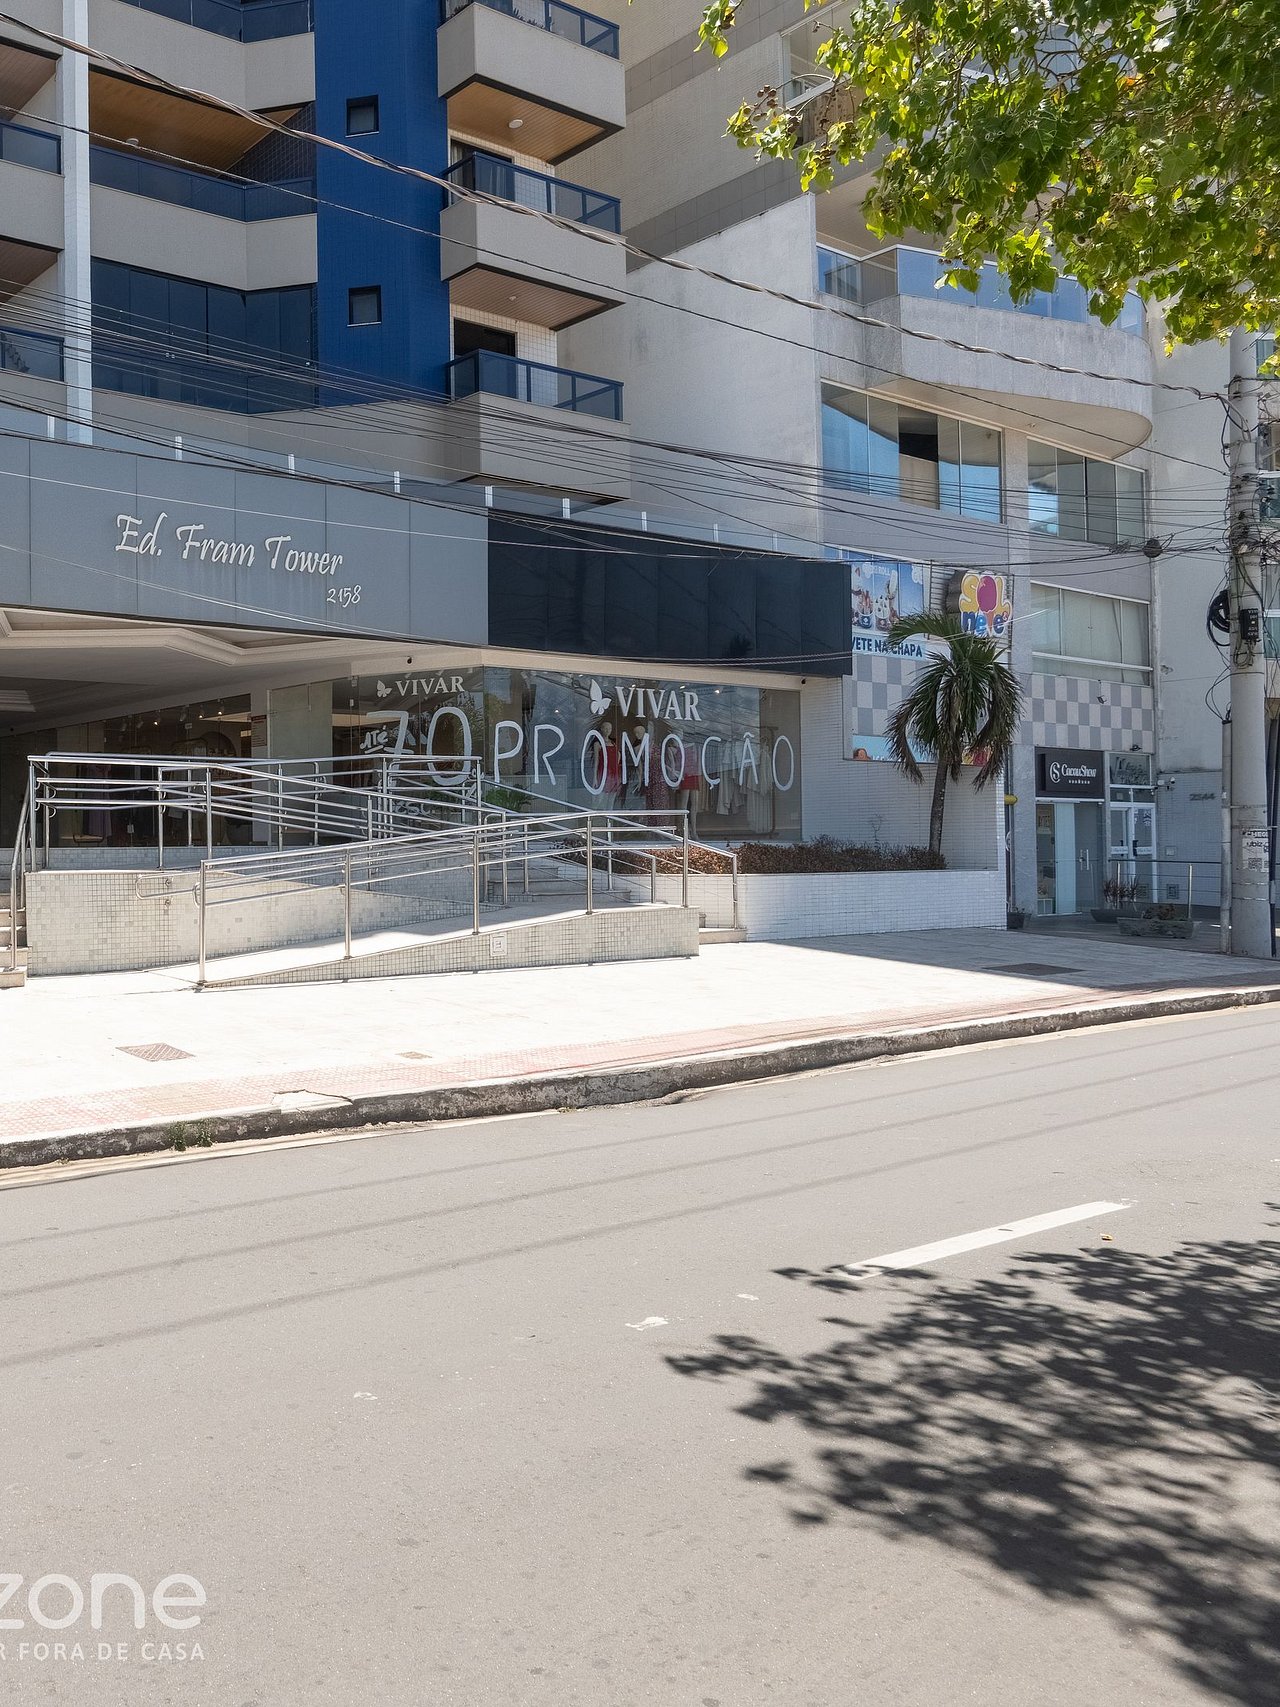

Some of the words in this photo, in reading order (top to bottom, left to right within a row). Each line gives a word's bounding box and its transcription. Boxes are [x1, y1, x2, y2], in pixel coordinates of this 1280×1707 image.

[115, 511, 168, 557] Ed.
[175, 523, 256, 568] Fram
[265, 535, 344, 576] Tower
[326, 584, 362, 608] 2158
[395, 676, 466, 697] VIVAR
[614, 685, 702, 722] VIVAR
[493, 719, 796, 796] PROMOÇÃO
